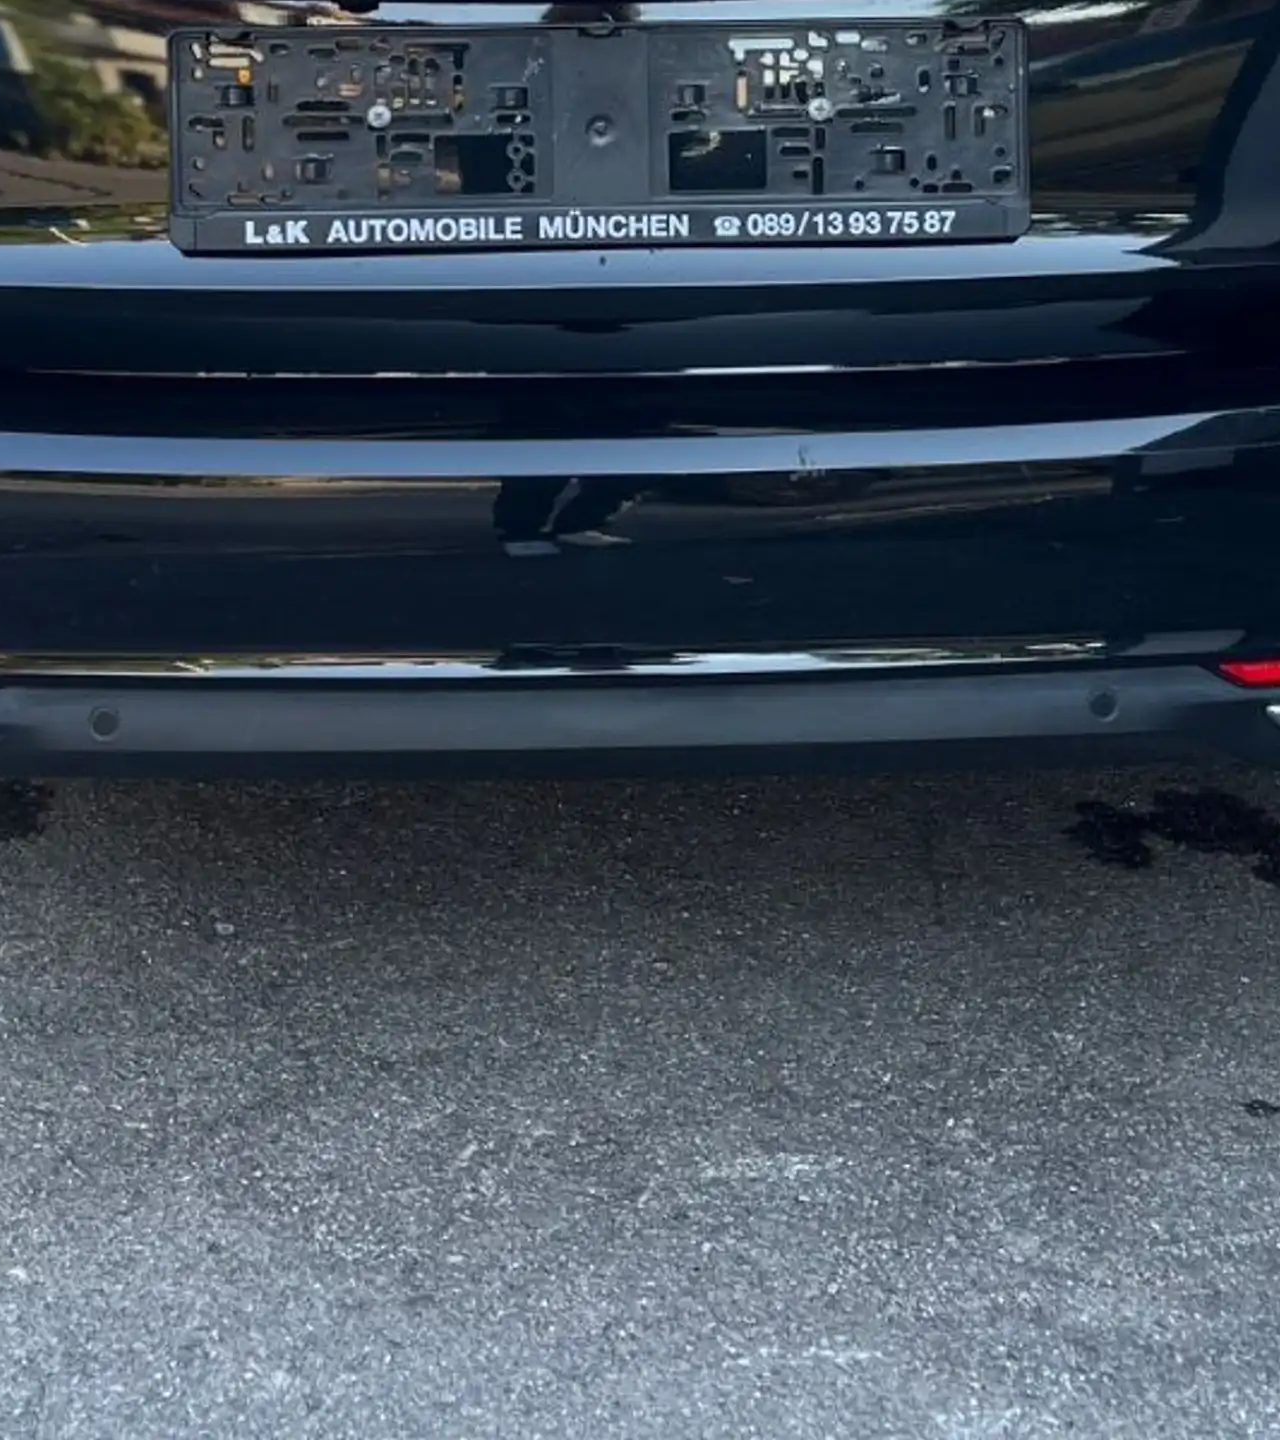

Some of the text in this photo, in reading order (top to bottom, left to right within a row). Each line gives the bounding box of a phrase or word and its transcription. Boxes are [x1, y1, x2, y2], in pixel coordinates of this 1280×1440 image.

[245, 220, 310, 245] L&K
[326, 216, 523, 243] AUTOMOBILE
[538, 211, 690, 239] MÜNCHEN
